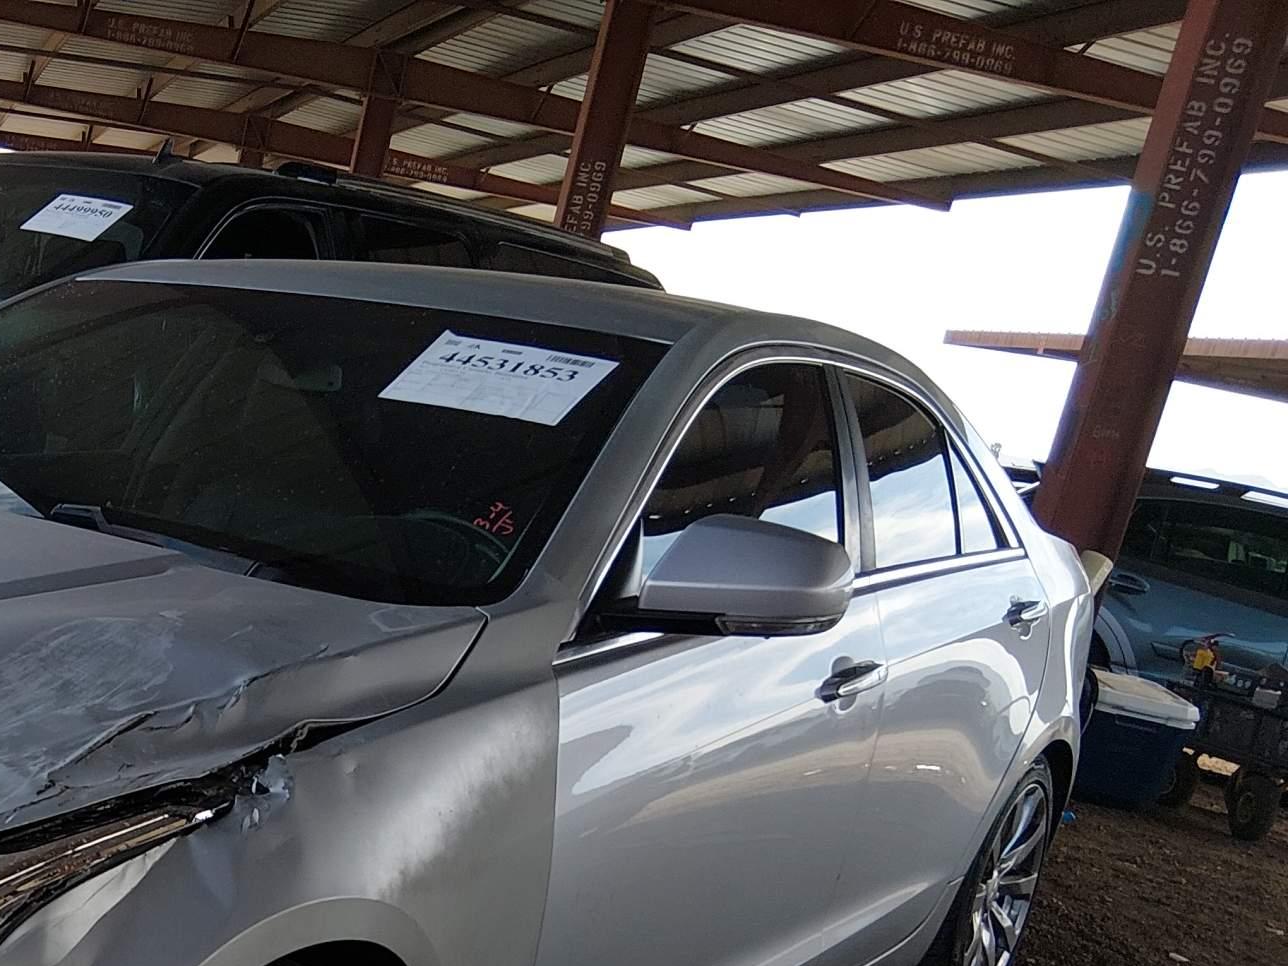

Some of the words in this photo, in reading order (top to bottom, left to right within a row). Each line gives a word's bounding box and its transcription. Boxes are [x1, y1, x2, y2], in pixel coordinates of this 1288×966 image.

[932, 28, 986, 52] PREFAB
[1136, 226, 1168, 276] U.S.
[1158, 99, 1207, 208] PREFAB
[1196, 33, 1230, 85] INC.
[1161, 37, 1253, 277] 1-866-799-0969
[564, 195, 583, 232] EFAB
[439, 351, 579, 382] 44531853
